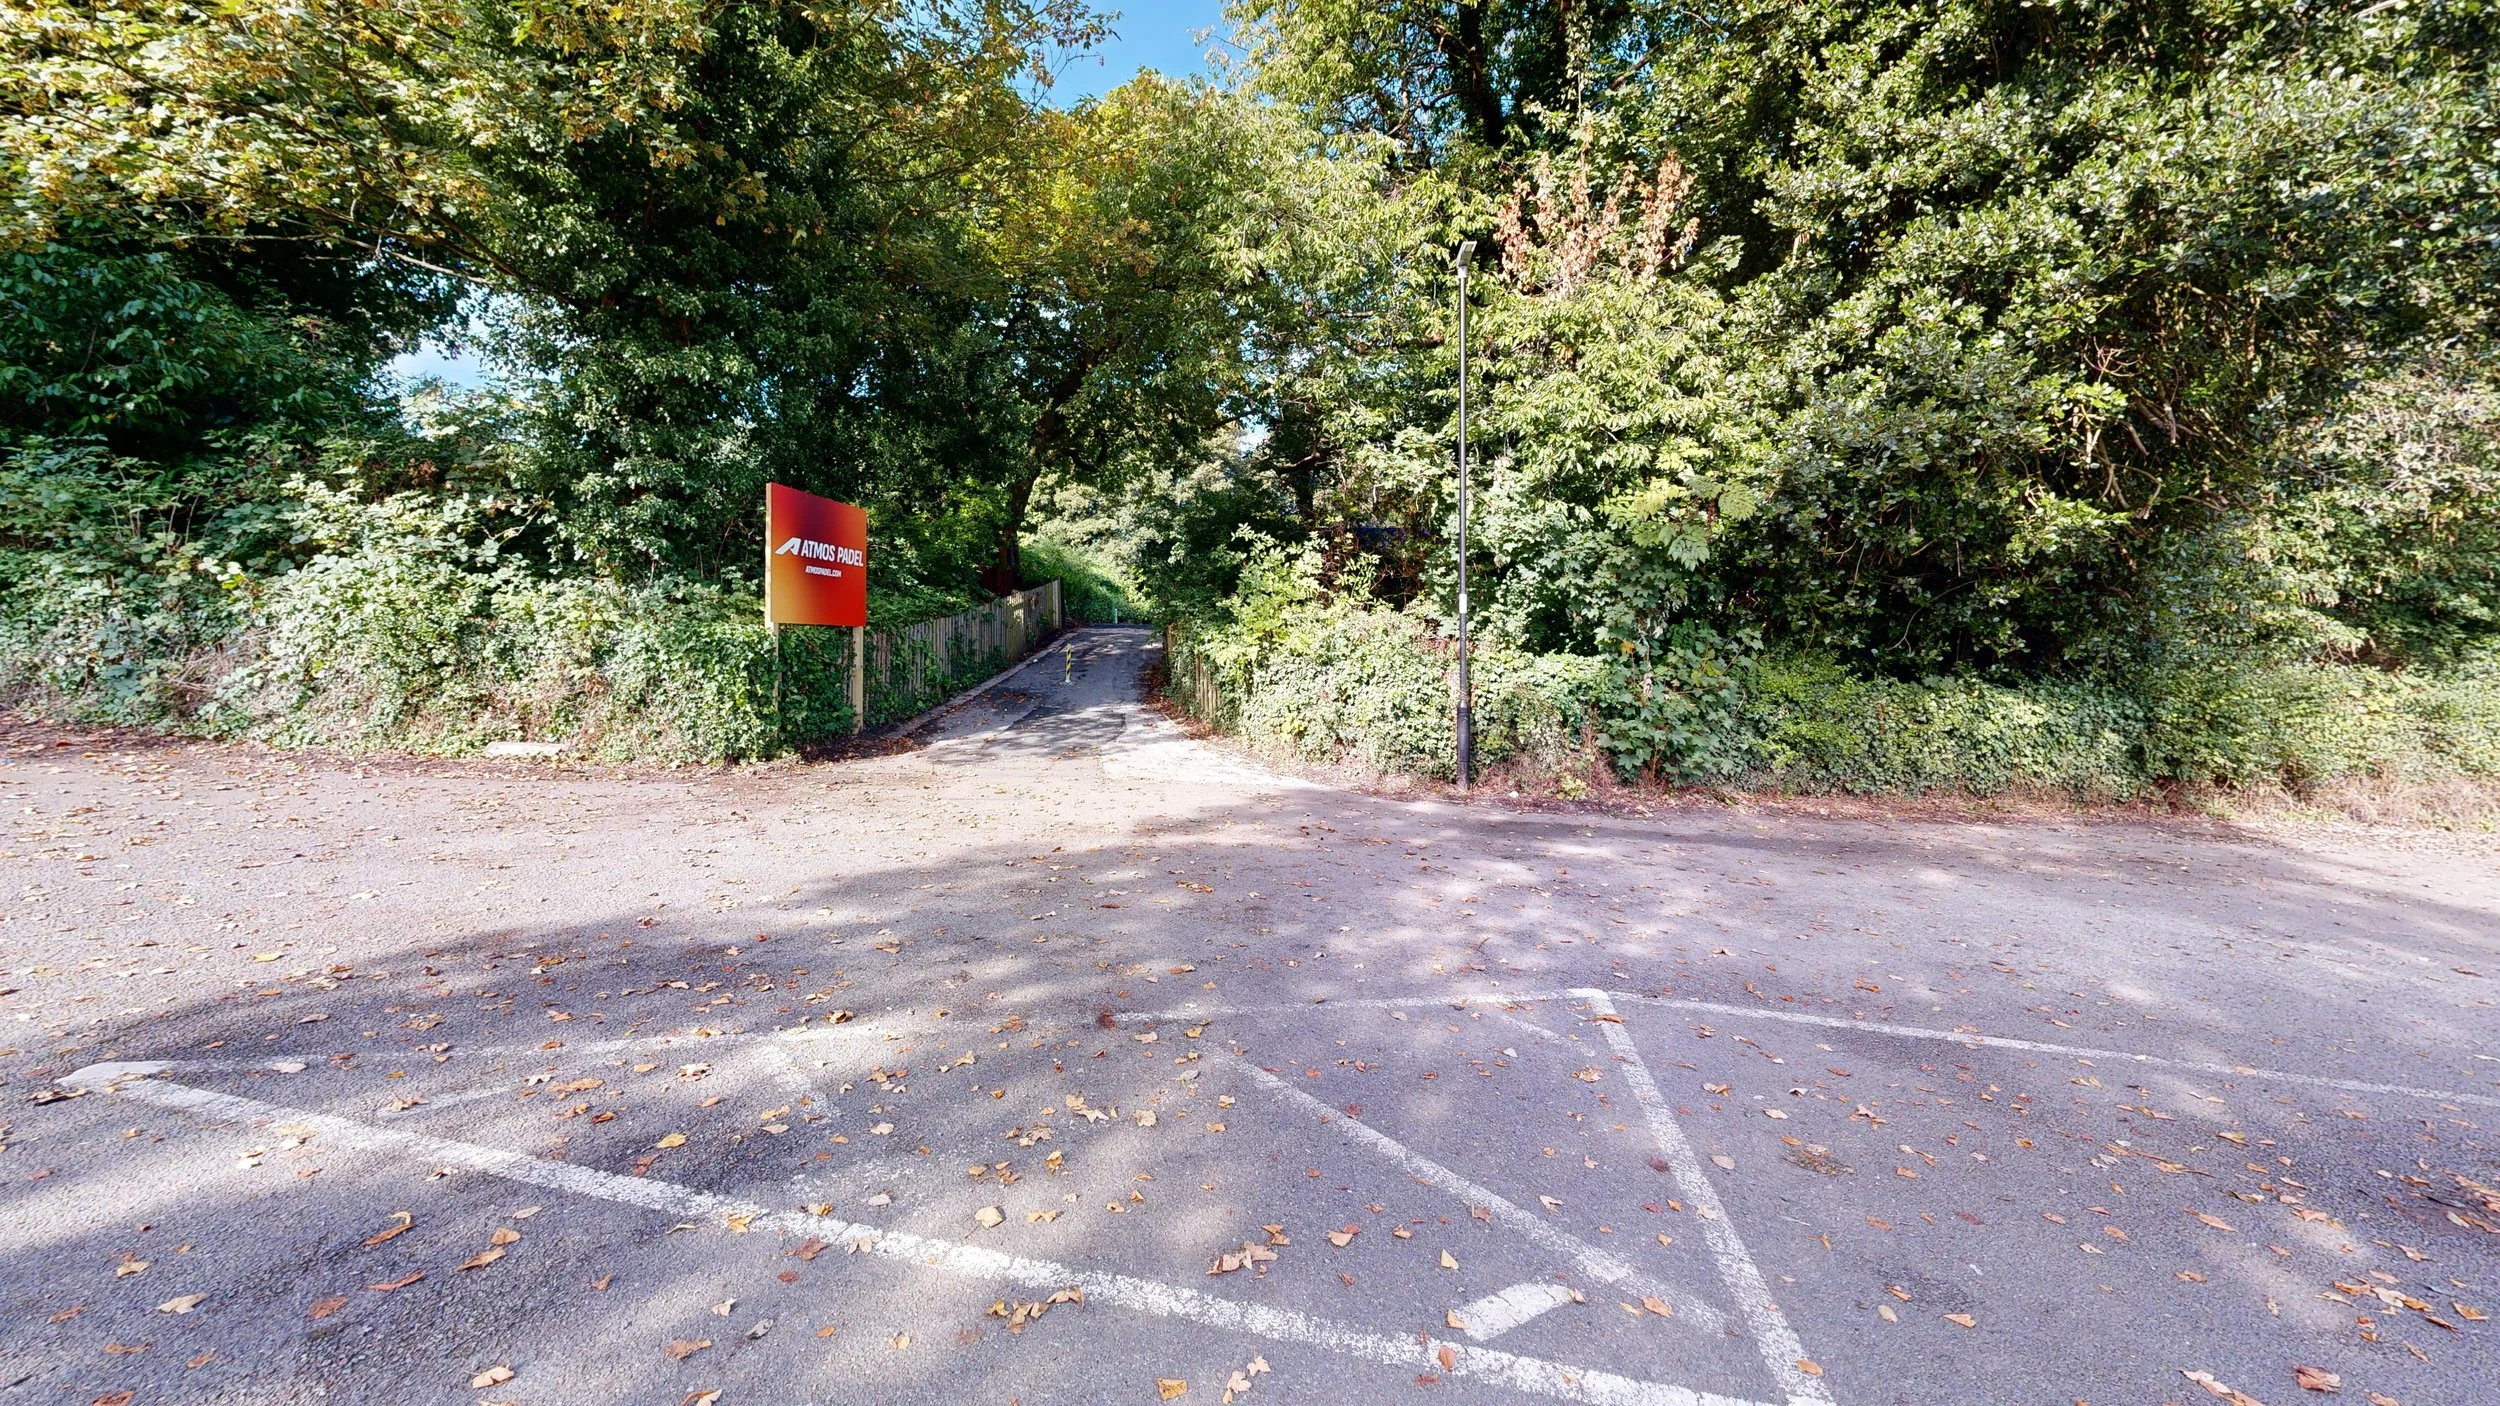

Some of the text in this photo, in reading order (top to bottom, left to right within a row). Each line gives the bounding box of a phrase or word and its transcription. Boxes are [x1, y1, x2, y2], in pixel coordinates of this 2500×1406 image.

[801, 539, 864, 566] ATMOS PADEL
[805, 565, 841, 577] ATMOSPADEL.COM
